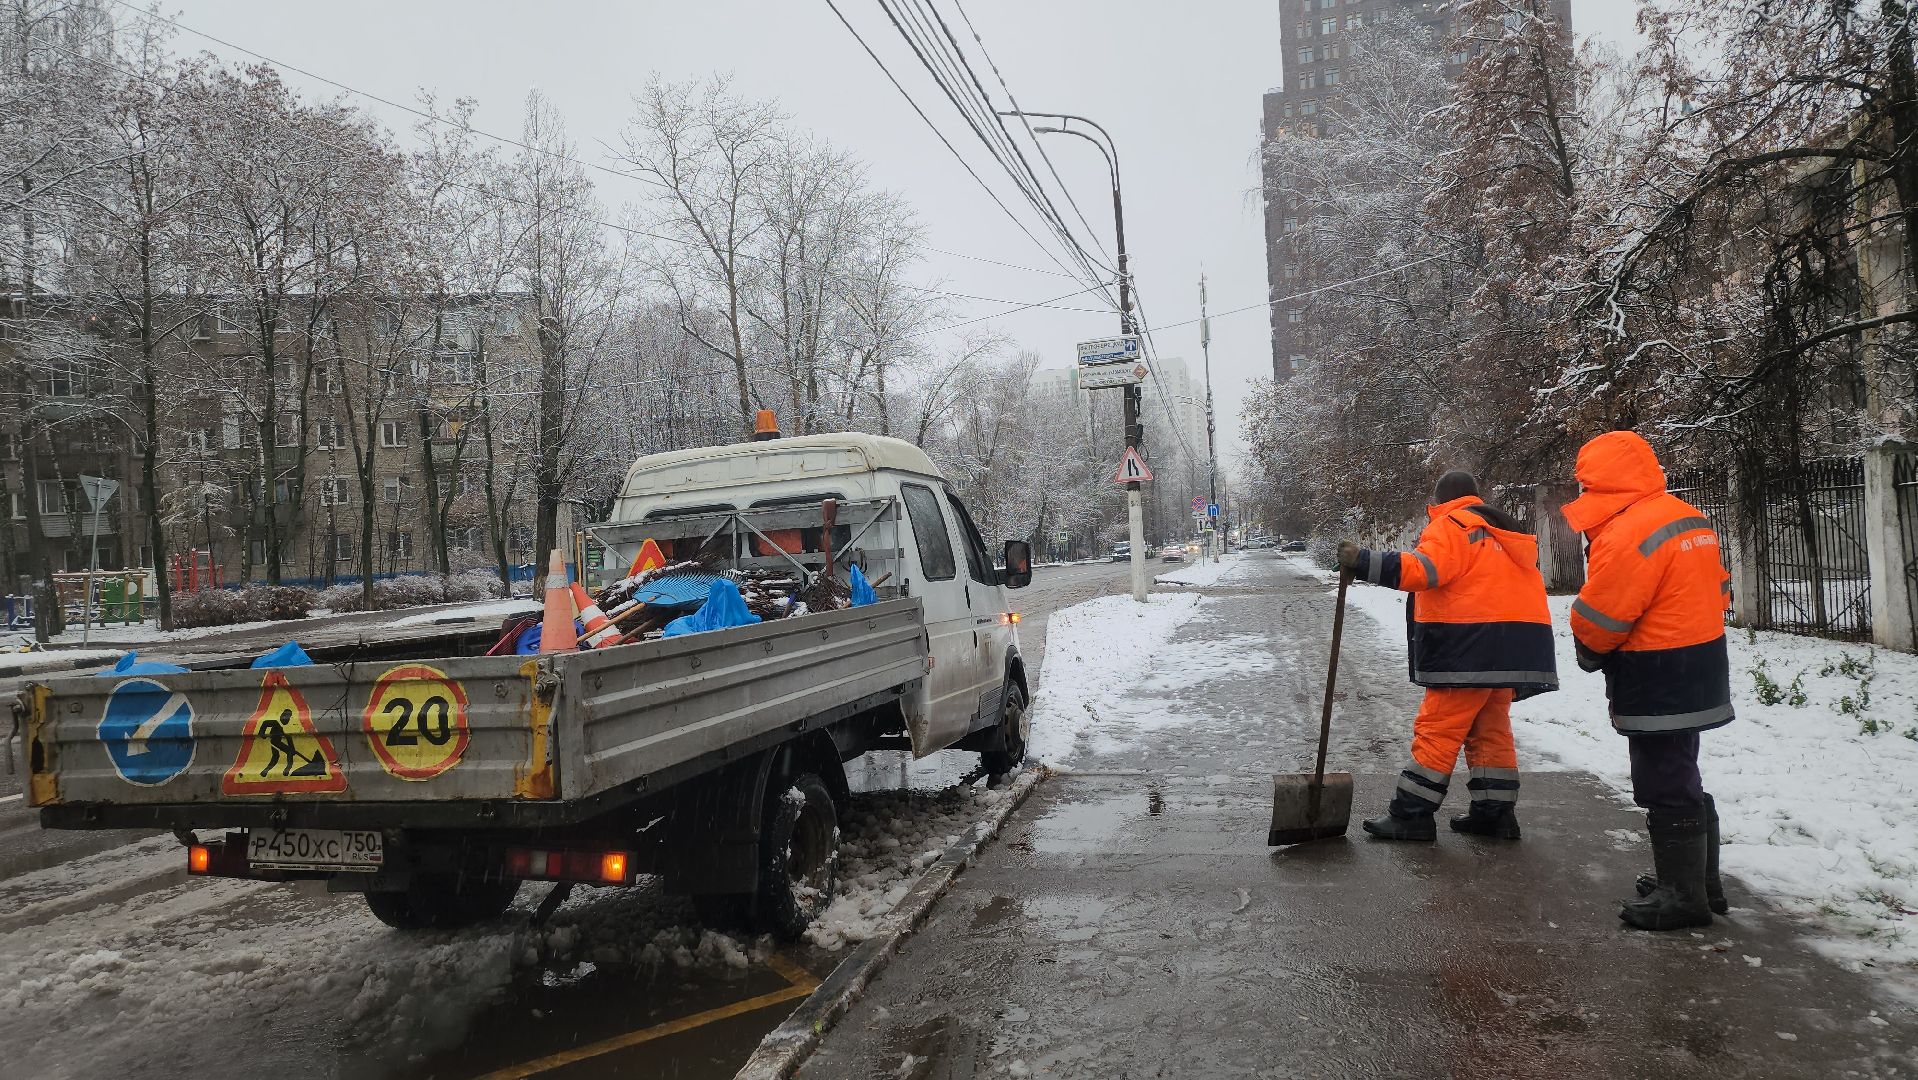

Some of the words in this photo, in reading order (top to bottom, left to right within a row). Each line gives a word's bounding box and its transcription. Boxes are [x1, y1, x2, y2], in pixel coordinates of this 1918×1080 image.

[383, 696, 451, 746] 20
[255, 831, 339, 858] Р450ХС
[343, 832, 377, 852] 750
[352, 852, 369, 861] RUS
